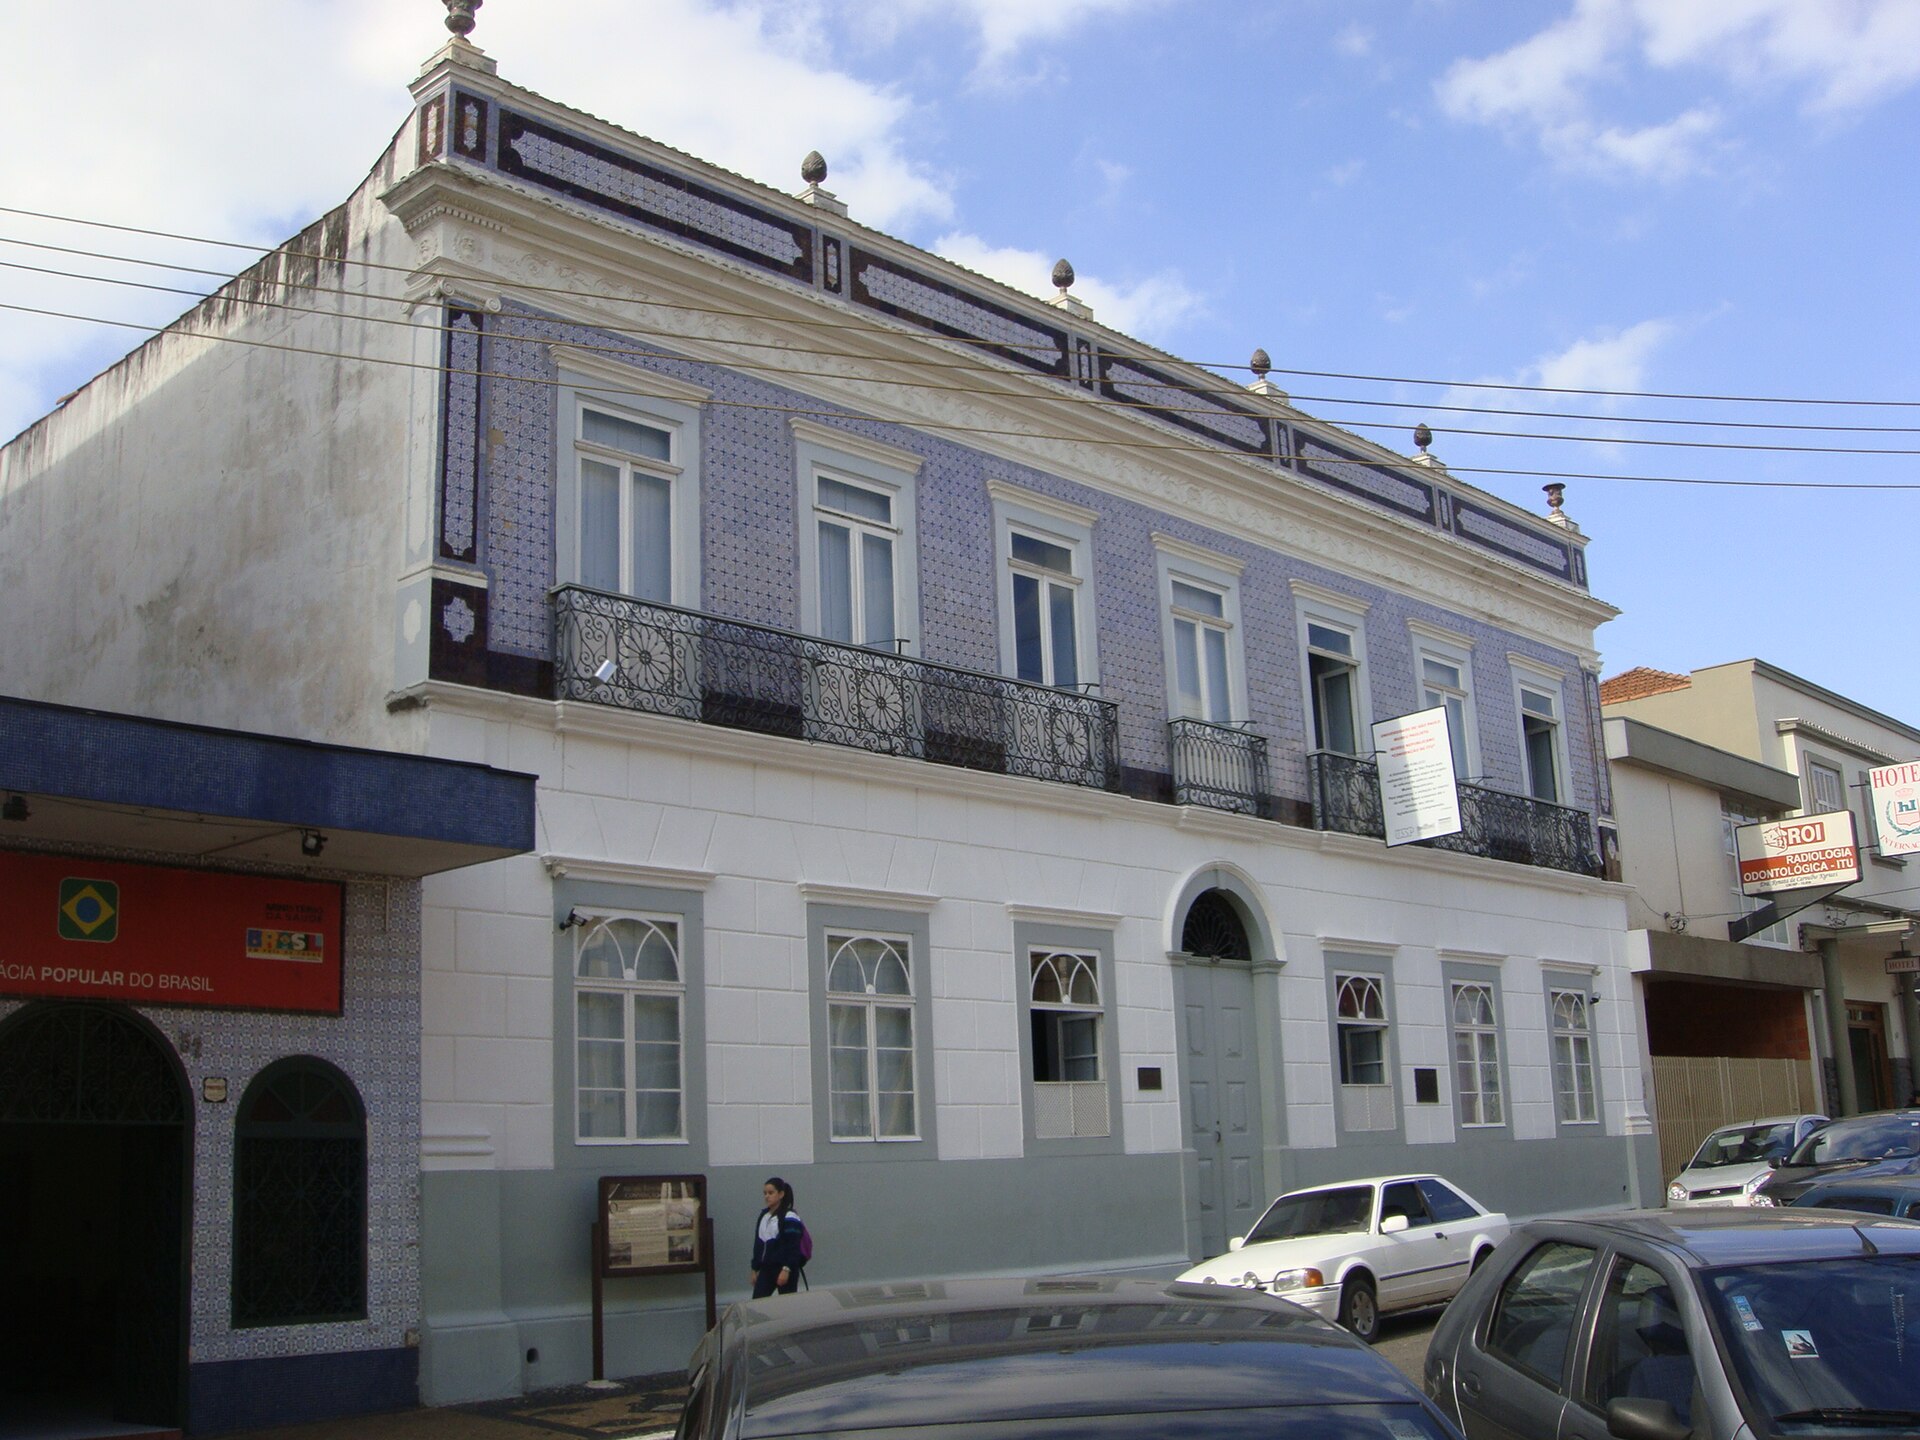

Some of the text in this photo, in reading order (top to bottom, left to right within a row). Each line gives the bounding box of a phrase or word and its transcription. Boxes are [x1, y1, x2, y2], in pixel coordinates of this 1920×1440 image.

[1787, 824, 1822, 844] ROI
[1786, 848, 1852, 865] RADIOLOGIA
[1743, 860, 1829, 882] ODONTOLÓGICA
[1836, 858, 1854, 869] ITU
[41, 967, 124, 986] POPULAR
[129, 972, 154, 988] DO
[158, 974, 215, 992] BRASIL
